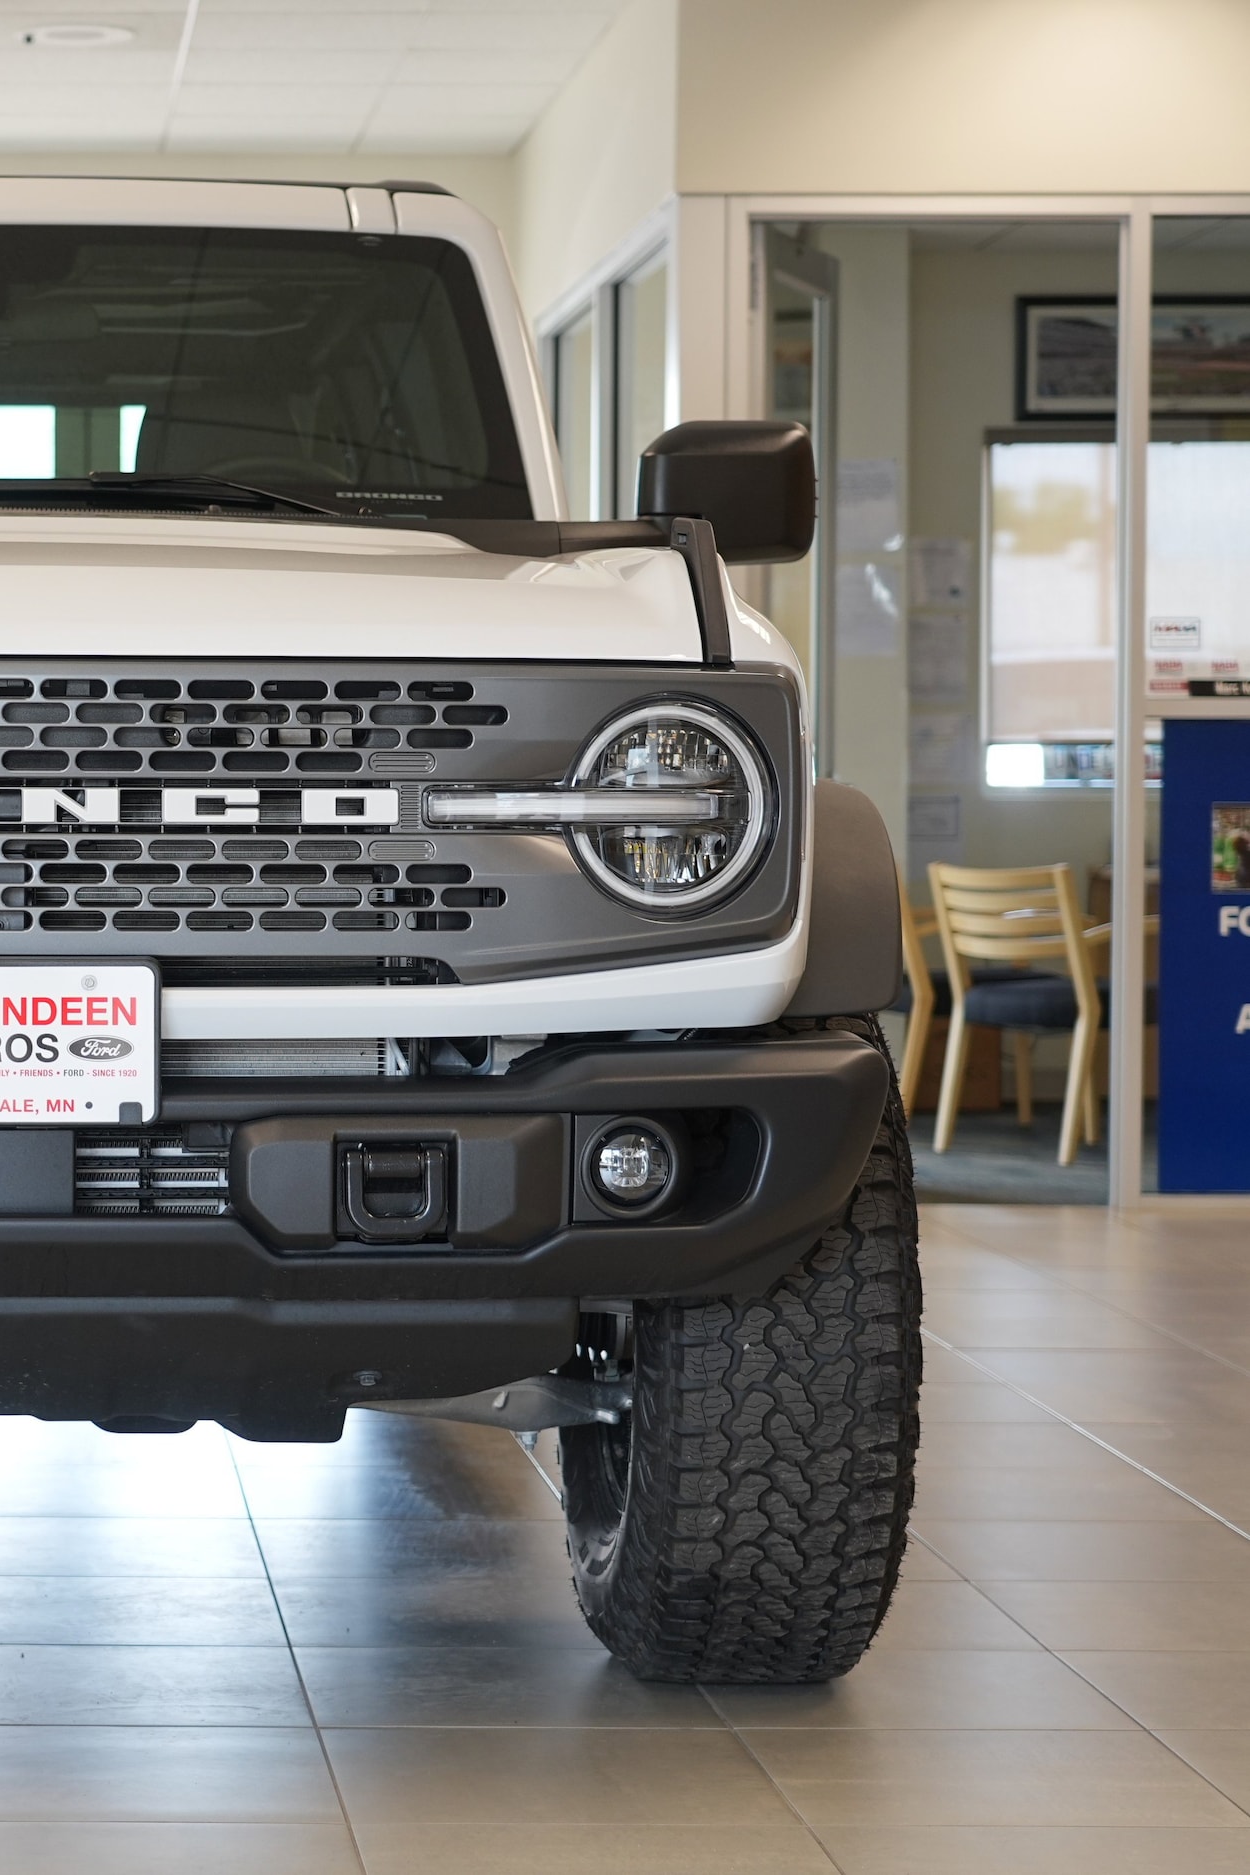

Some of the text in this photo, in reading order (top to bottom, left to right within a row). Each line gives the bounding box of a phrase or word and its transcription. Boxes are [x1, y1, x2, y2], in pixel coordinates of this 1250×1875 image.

[335, 491, 443, 501] BRONCO
[80, 1038, 121, 1058] Ford
[19, 1069, 54, 1077] FRIENDS
[63, 1069, 85, 1077] FORD
[92, 1069, 116, 1077] SINCE
[118, 1069, 137, 1077] 1920
[46, 1099, 75, 1113] MN
